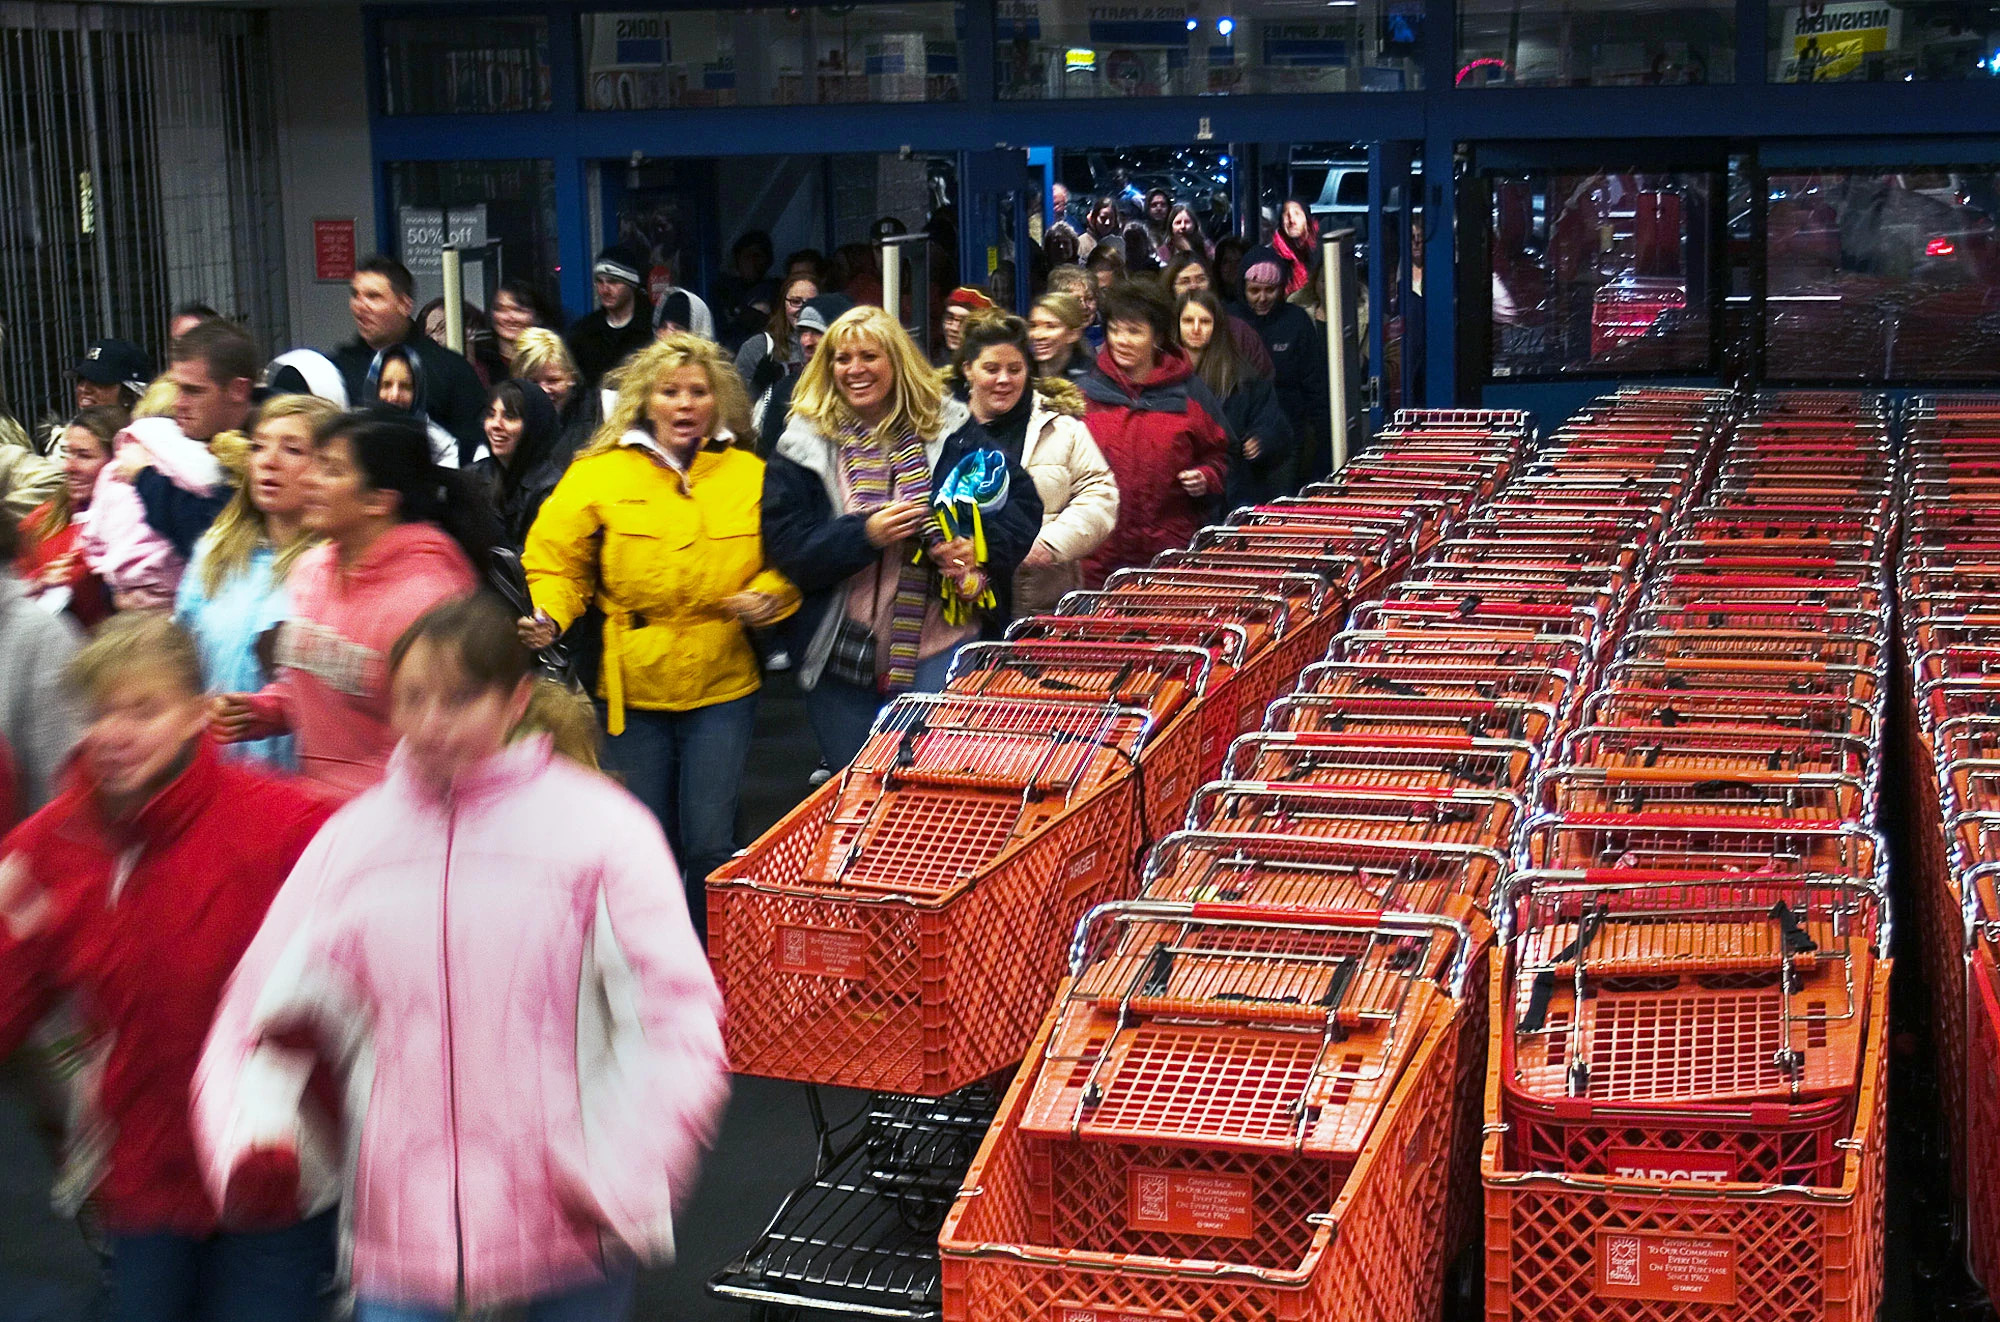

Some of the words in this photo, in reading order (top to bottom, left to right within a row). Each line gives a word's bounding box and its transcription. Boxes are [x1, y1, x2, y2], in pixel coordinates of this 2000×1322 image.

[407, 227, 444, 244] 50%
[448, 227, 472, 244] off
[1068, 850, 1098, 882] ARGET
